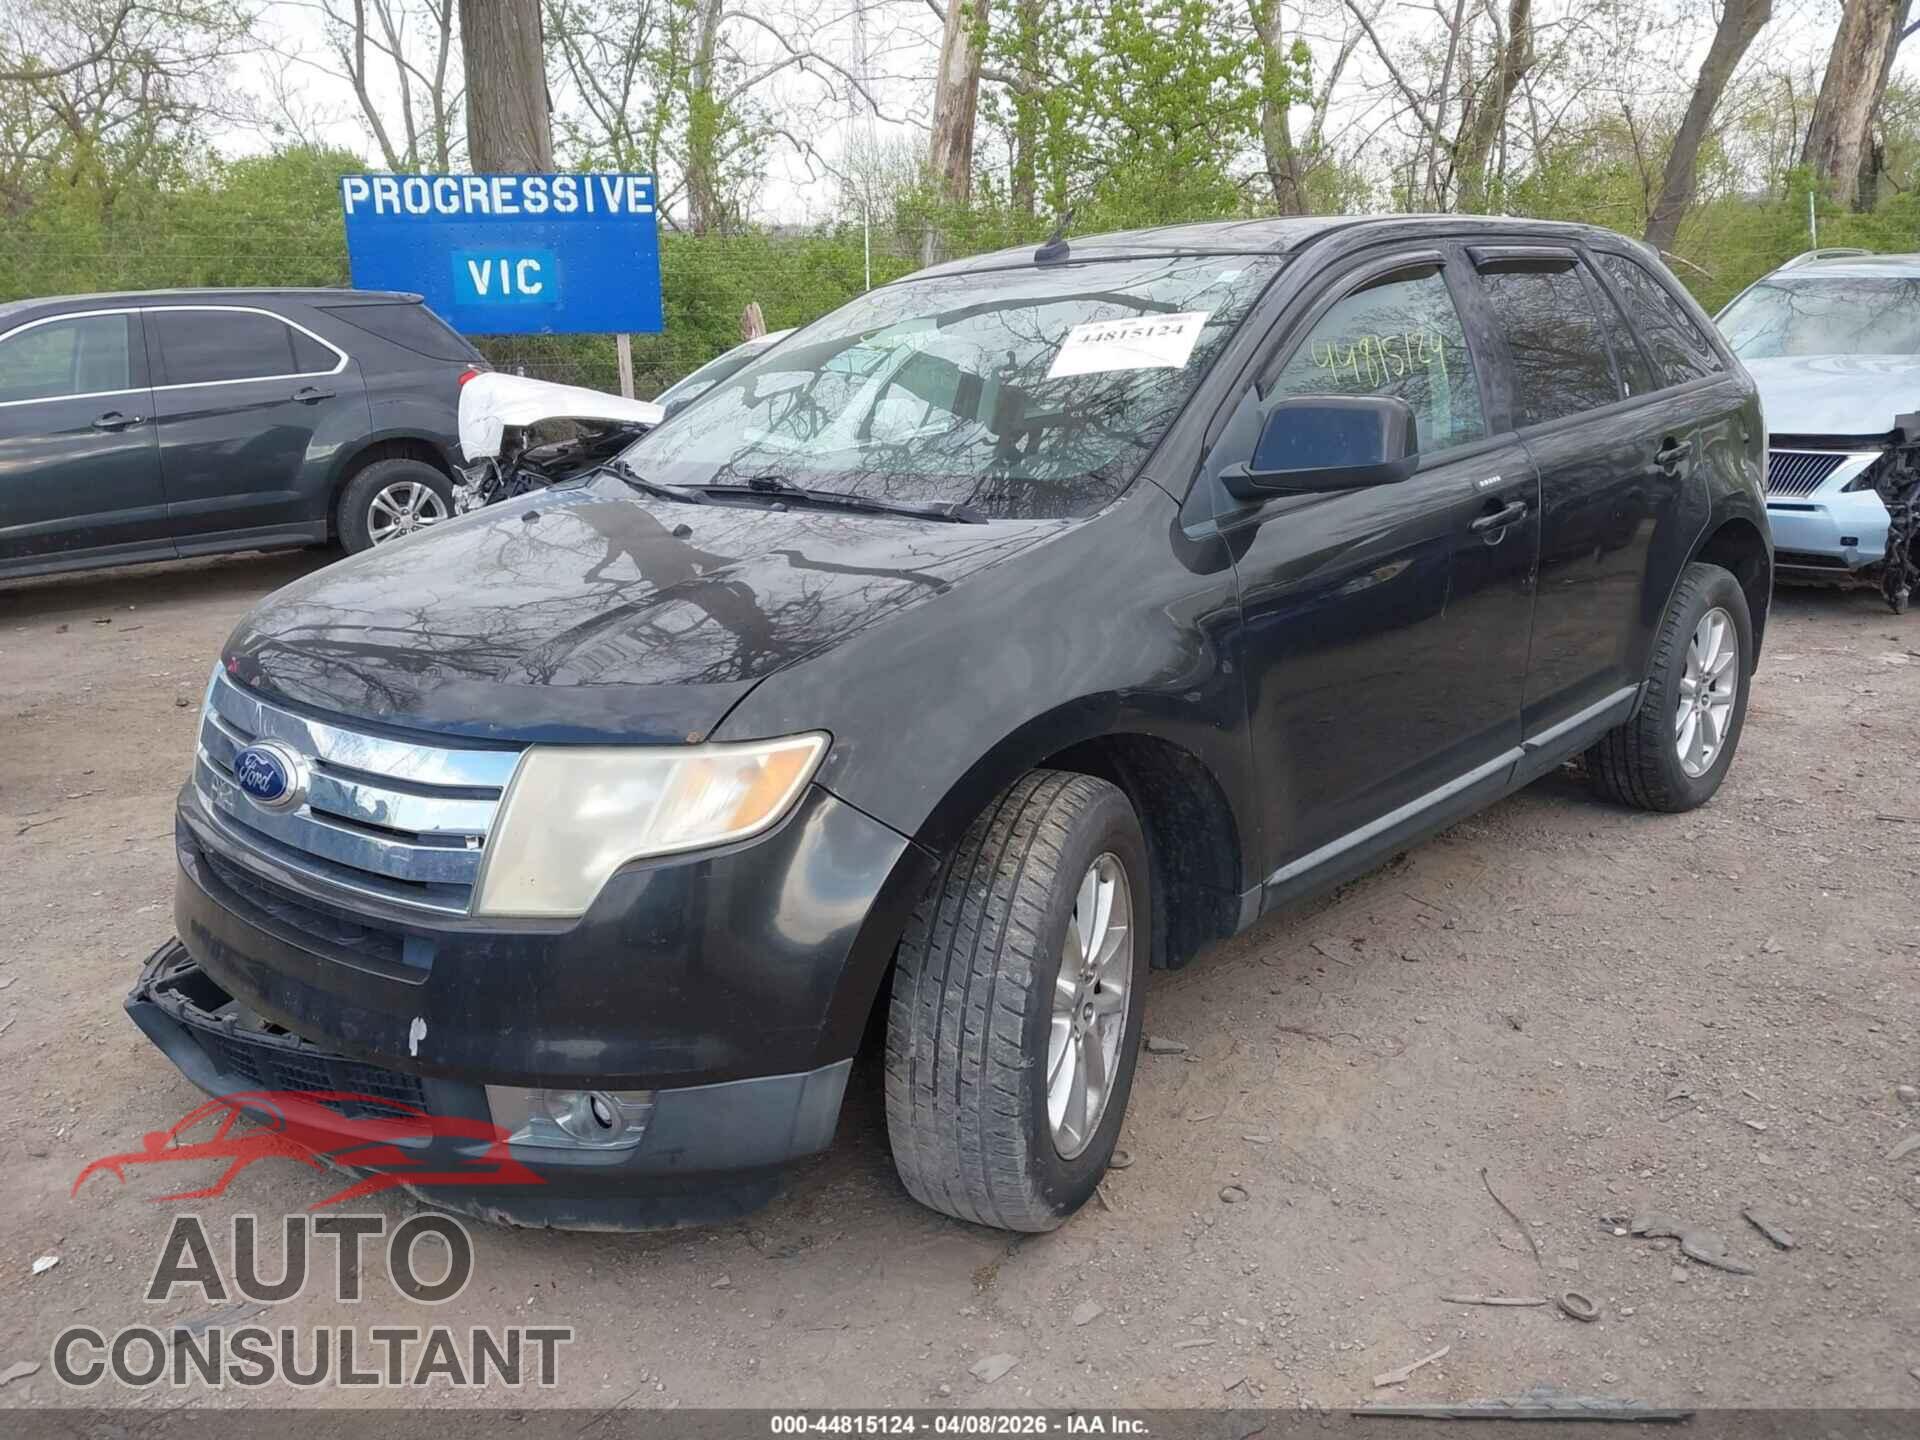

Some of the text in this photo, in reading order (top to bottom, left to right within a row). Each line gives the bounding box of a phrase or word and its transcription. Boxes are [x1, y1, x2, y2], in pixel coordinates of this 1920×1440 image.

[342, 176, 654, 215] PROGRESSIVE
[468, 258, 543, 295] VIC
[1077, 324, 1185, 344] 44815124
[239, 753, 275, 793] Ford
